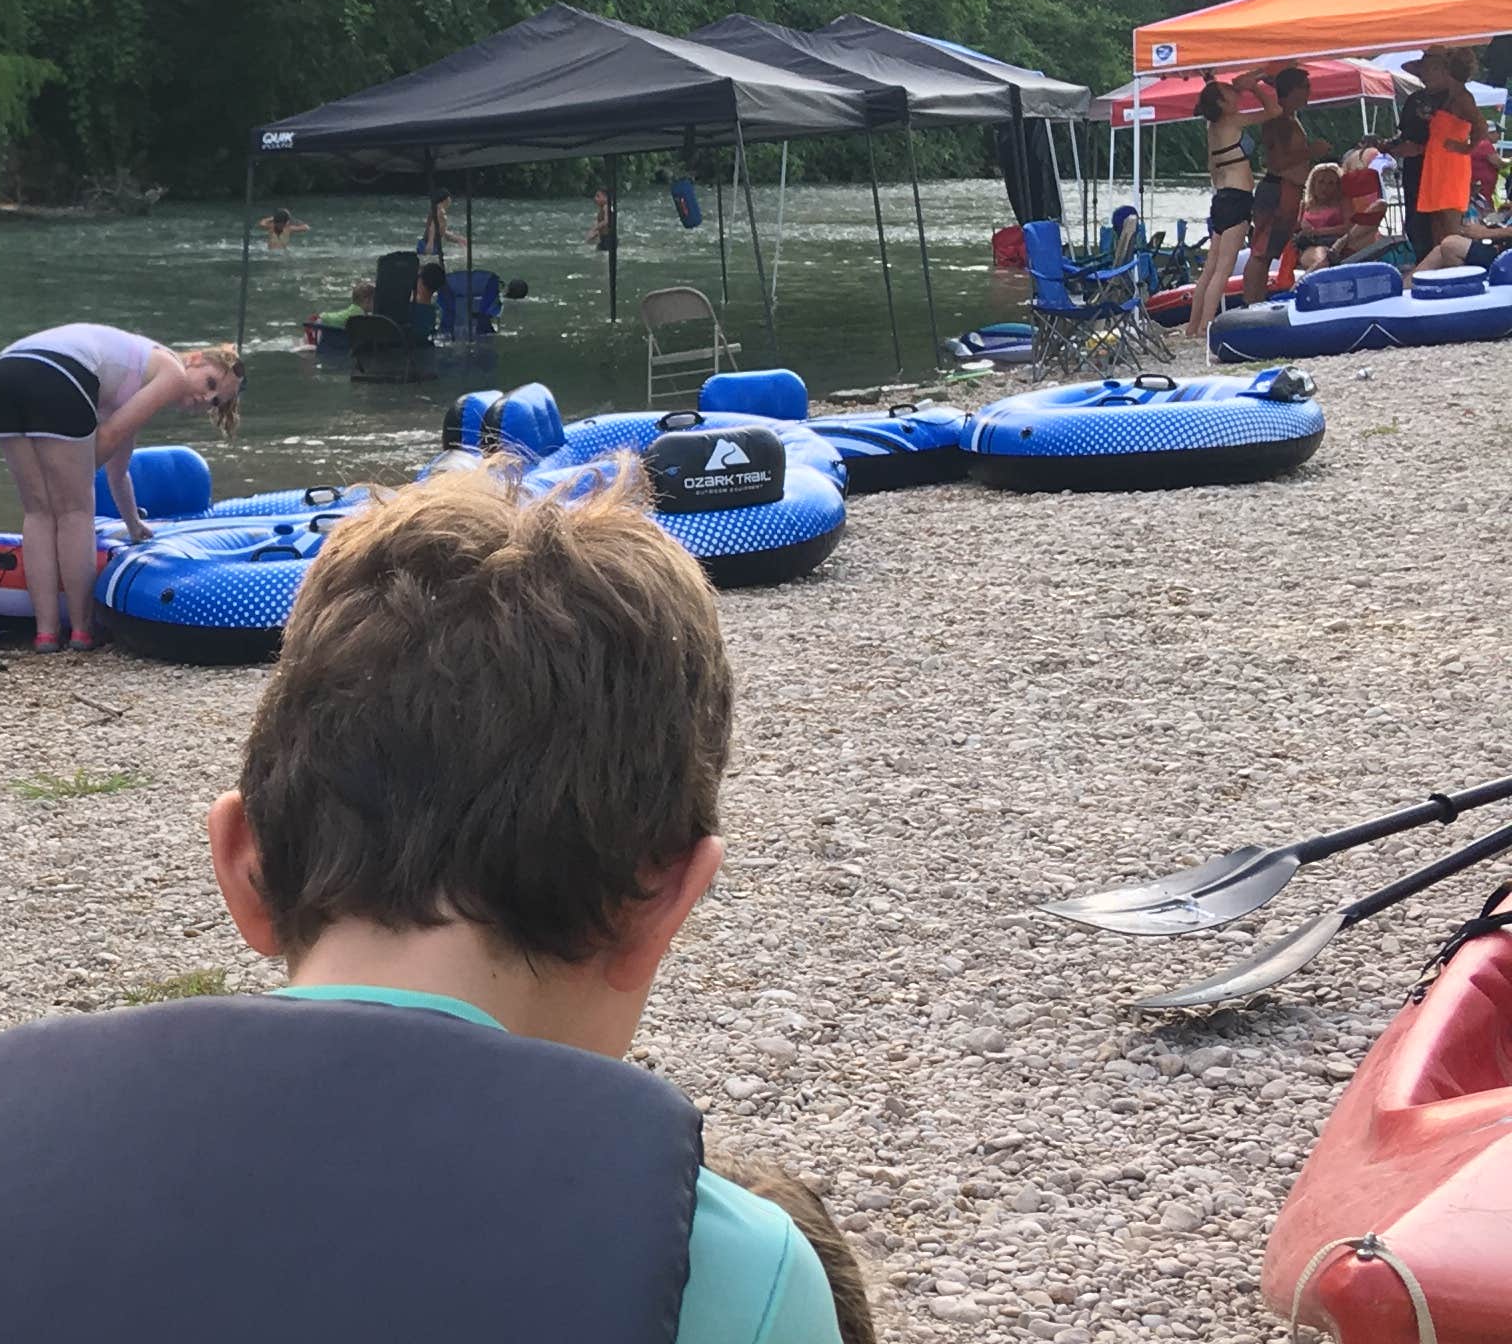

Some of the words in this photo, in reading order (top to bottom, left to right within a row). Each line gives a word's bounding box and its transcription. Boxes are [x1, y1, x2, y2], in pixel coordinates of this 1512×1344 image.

[262, 131, 295, 145] QUIK
[683, 474, 734, 489] OZARK
[735, 471, 772, 485] TRAIL
